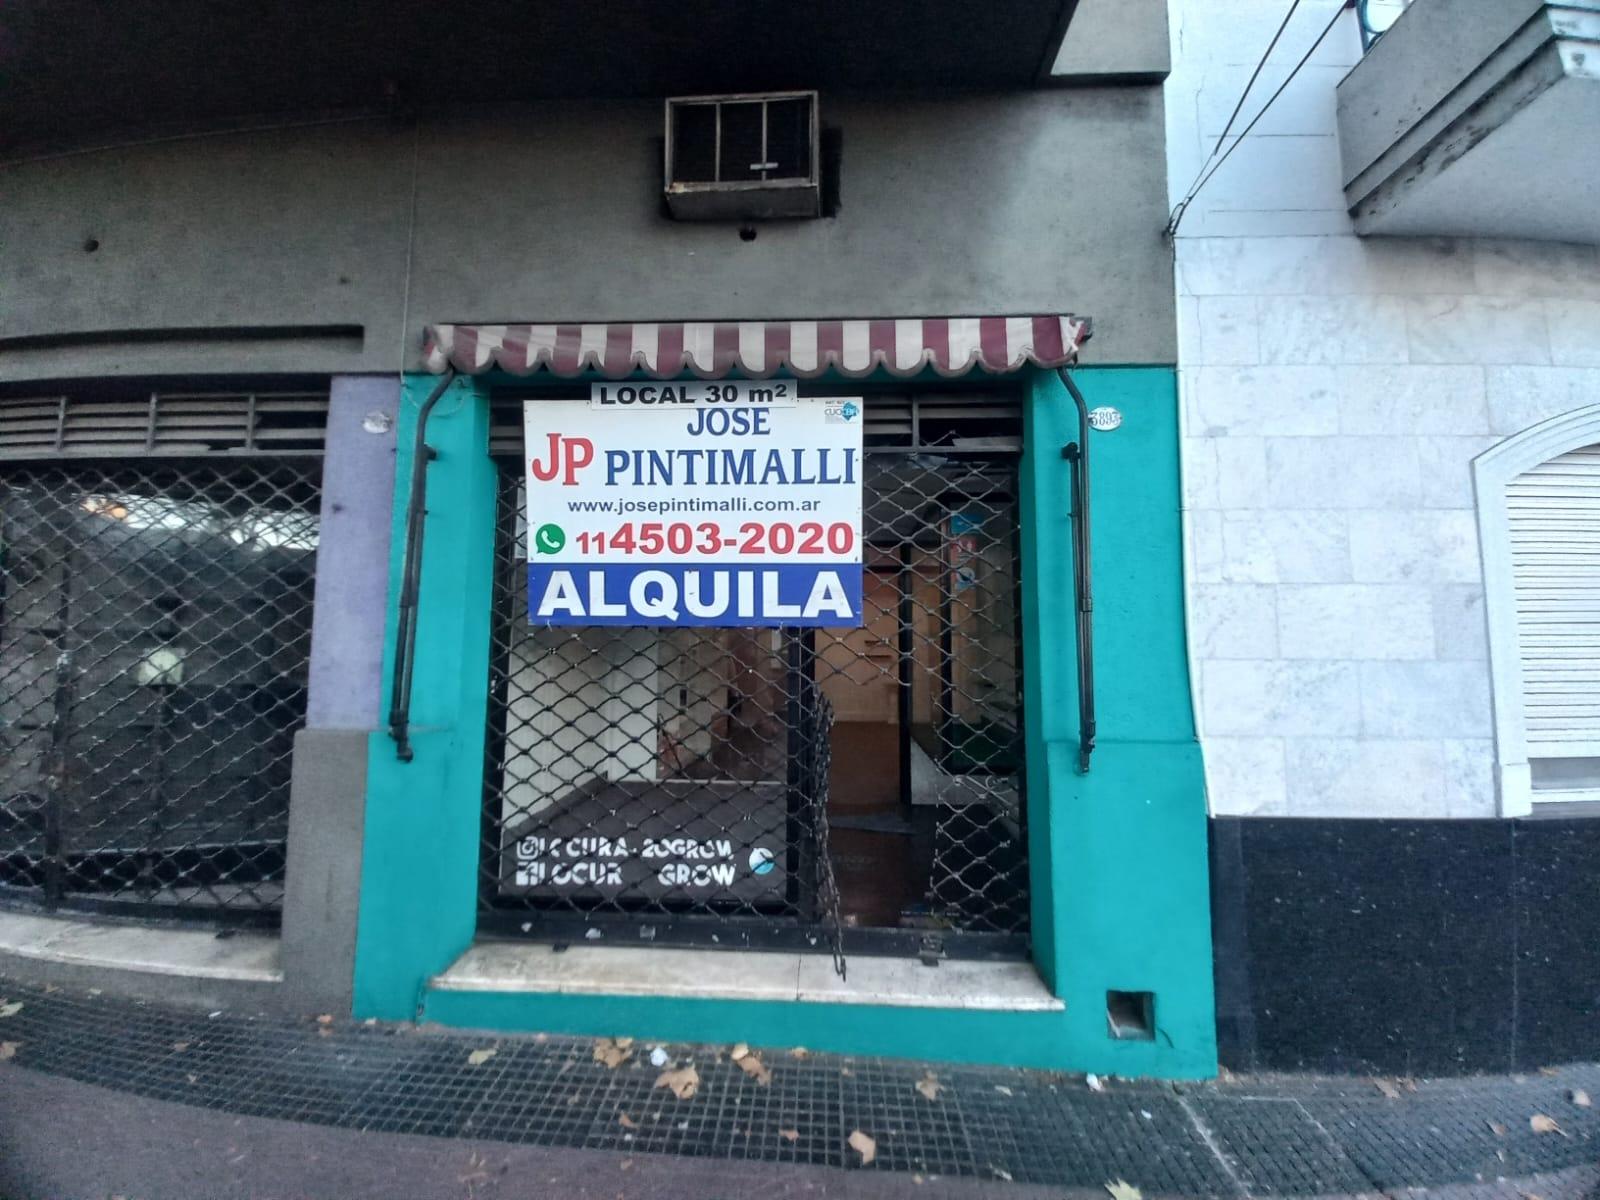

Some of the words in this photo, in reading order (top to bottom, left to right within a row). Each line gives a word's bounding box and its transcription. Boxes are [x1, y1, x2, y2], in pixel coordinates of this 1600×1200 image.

[600, 386, 698, 405] LOCAL
[705, 384, 738, 403] 30
[687, 407, 771, 436] JOSE
[532, 433, 594, 486] JP
[604, 448, 856, 486] PINTIMALLI
[568, 497, 821, 515] www.josepintimalli.com.ar
[537, 570, 854, 622] ALQUILA
